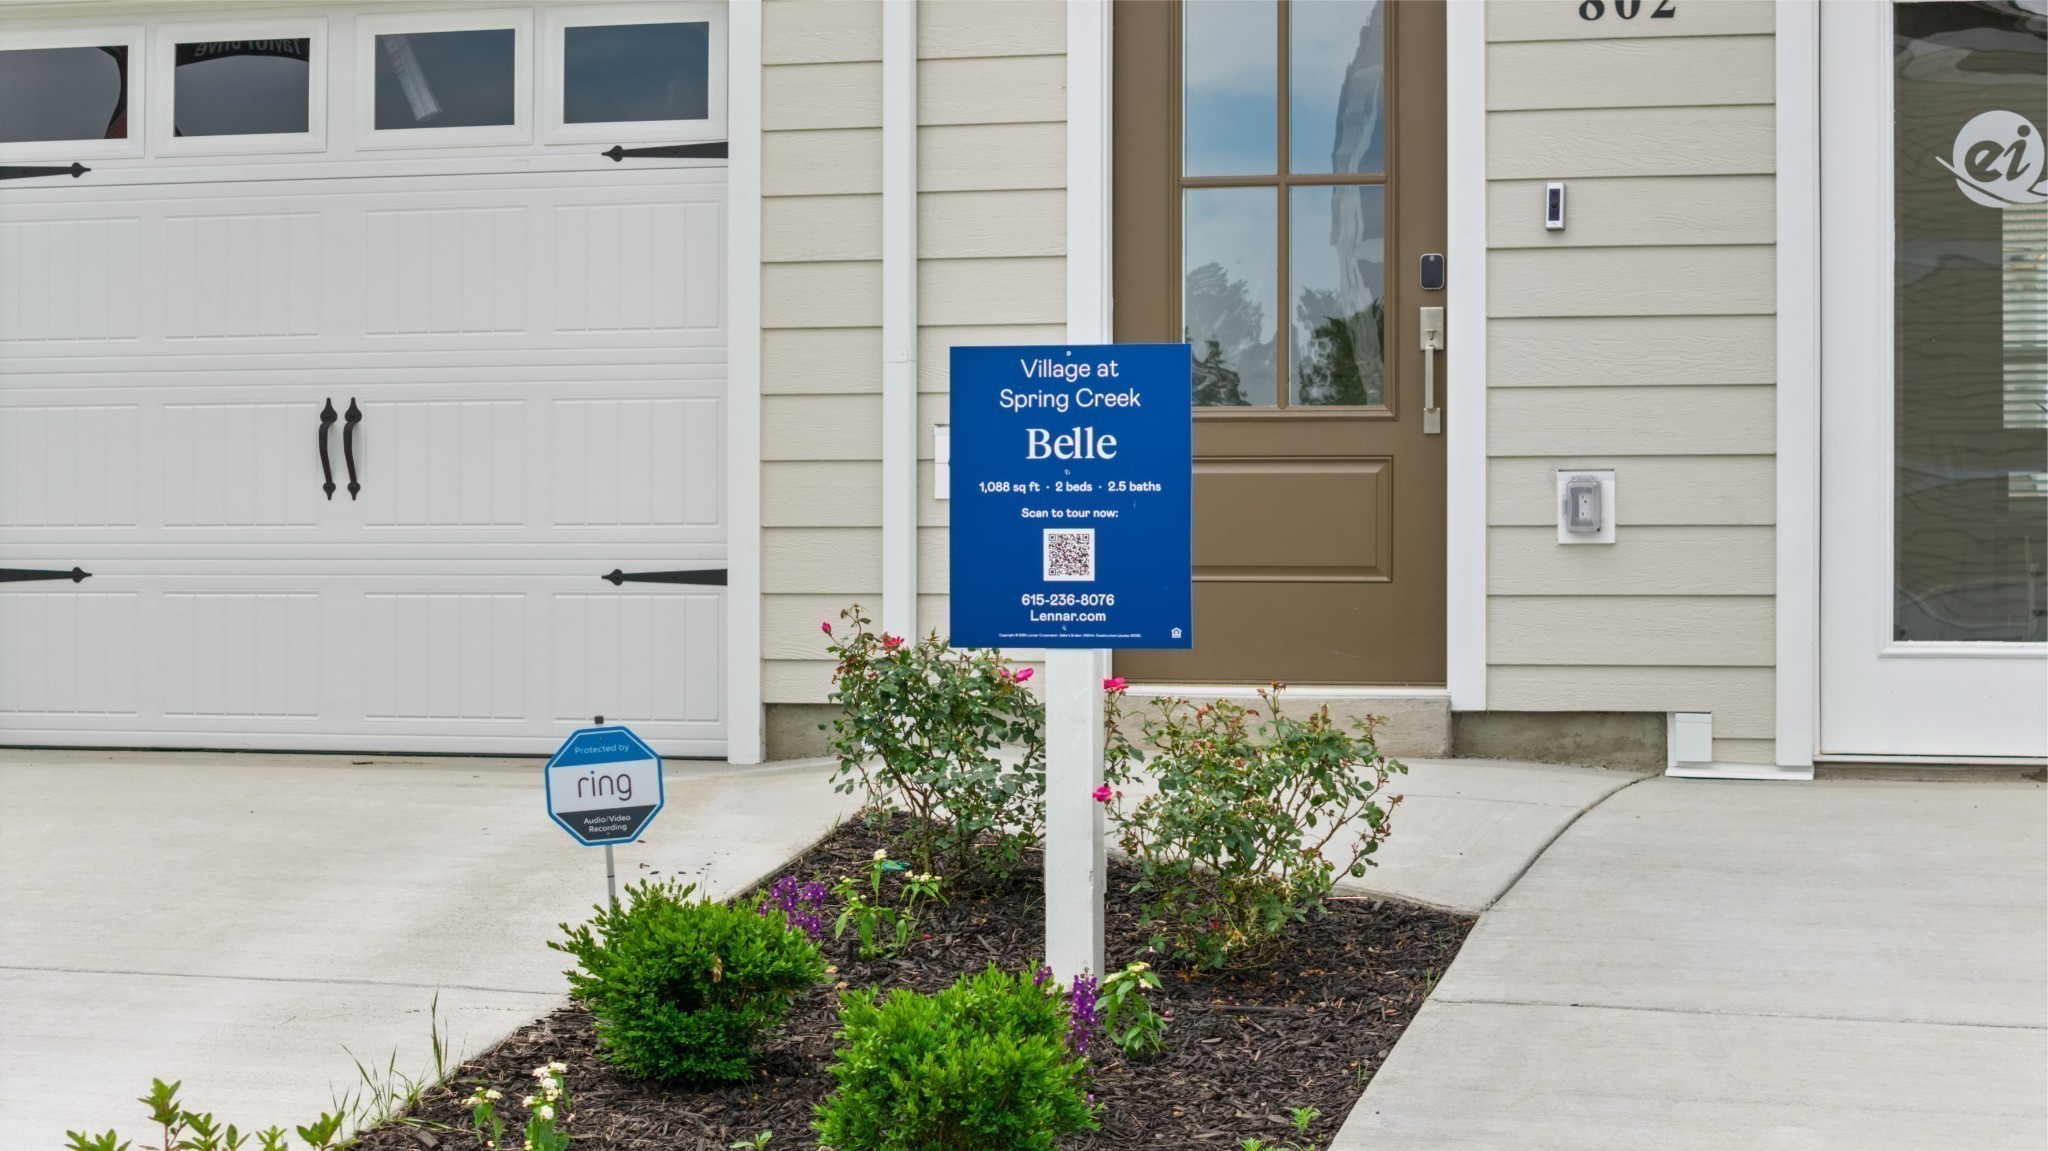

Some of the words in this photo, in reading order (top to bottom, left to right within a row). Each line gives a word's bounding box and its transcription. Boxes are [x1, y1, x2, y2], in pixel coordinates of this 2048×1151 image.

[1578, 0, 1676, 21] 802
[1964, 124, 2031, 183] ei
[1020, 358, 1091, 383] Village
[1096, 359, 1120, 378] at
[999, 388, 1069, 413] Spring
[1075, 387, 1141, 408] Creek
[1025, 426, 1117, 460] Belle
[978, 481, 1011, 494] 1,088
[1012, 483, 1027, 495] sq
[1028, 481, 1041, 492] ft
[1055, 480, 1064, 492] 2
[1065, 480, 1093, 492] beds
[1107, 480, 1127, 492] 2.5
[1128, 480, 1162, 492] baths
[1021, 507, 1049, 518] Scan
[1051, 508, 1064, 518] to
[1066, 508, 1091, 518] tour
[1093, 509, 1119, 518] now:
[1021, 593, 1116, 607] 615-236-8076
[1030, 609, 1107, 622] Lennar.com
[574, 744, 617, 755] Protected
[619, 743, 630, 753] by
[577, 770, 632, 802] ring
[583, 814, 632, 825] Audio/Video
[588, 823, 628, 833] Recording
